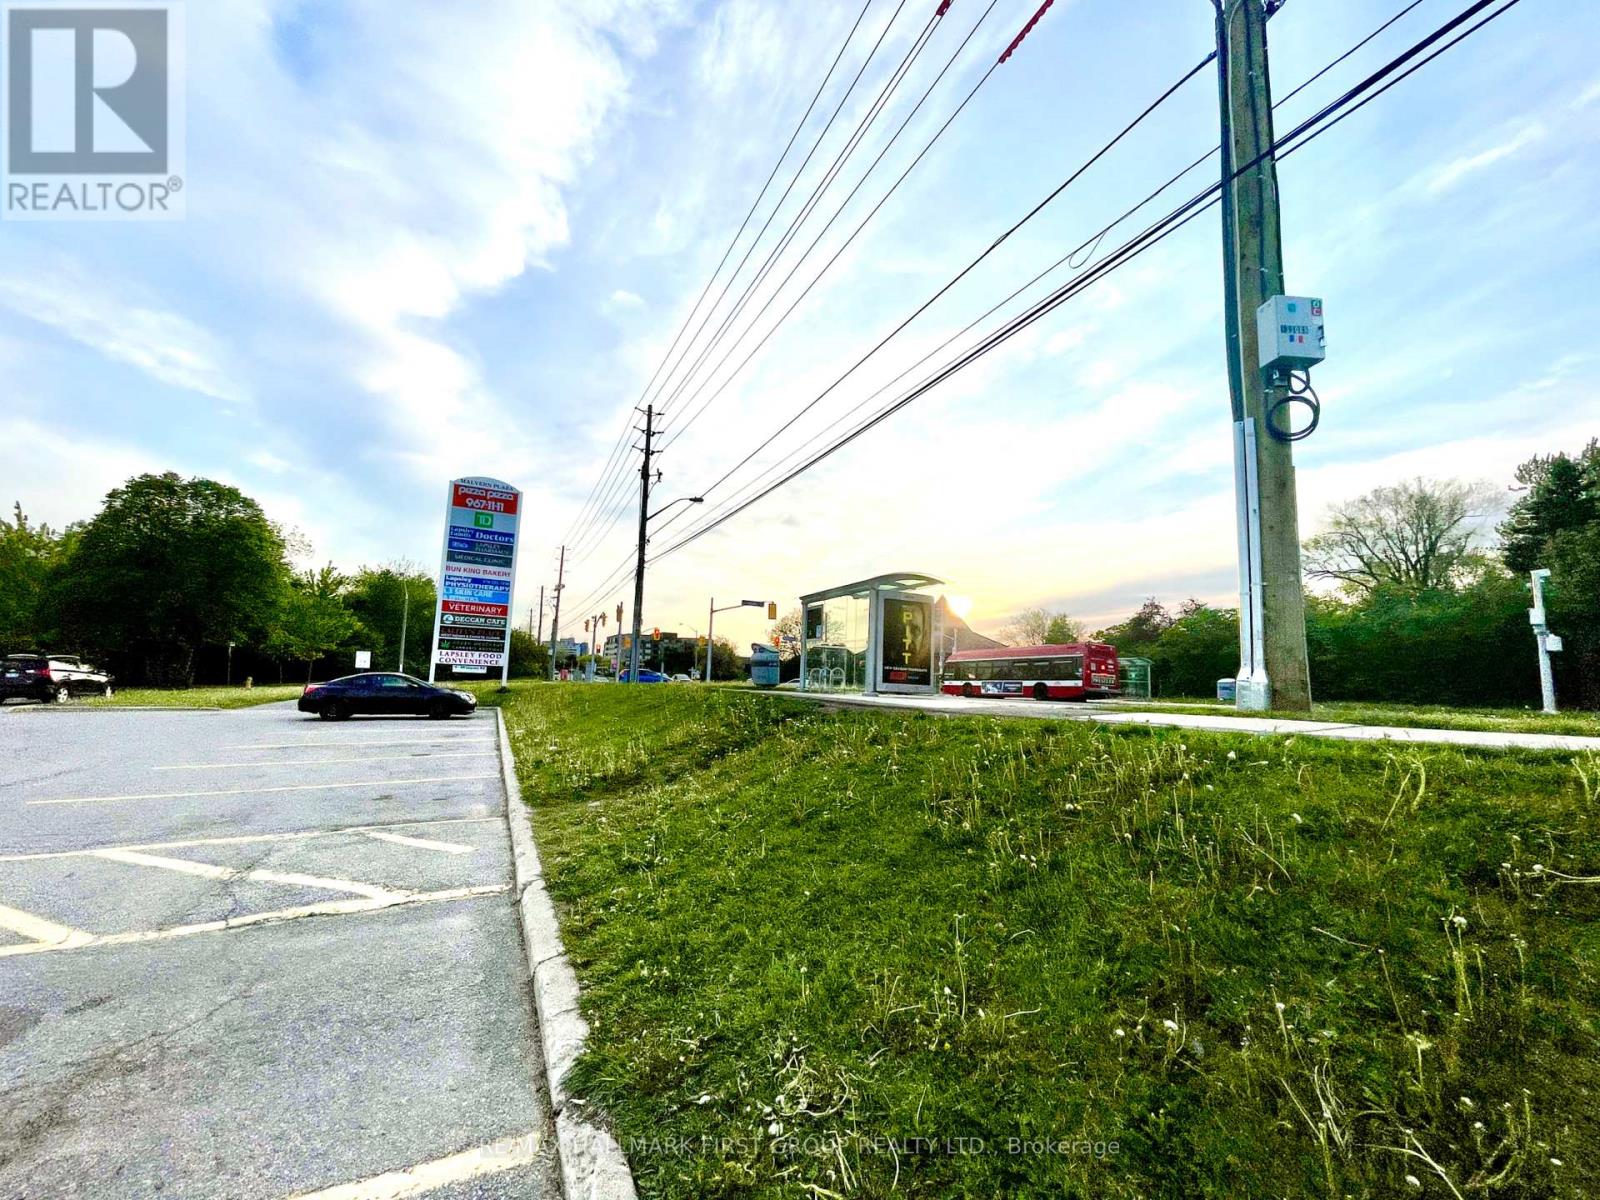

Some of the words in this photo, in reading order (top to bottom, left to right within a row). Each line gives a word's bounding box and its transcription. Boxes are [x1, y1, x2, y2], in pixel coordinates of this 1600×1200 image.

[478, 515, 492, 526] TD
[475, 531, 514, 542] Doctors
[445, 564, 462, 573] BUN
[463, 567, 481, 575] KING
[482, 569, 511, 577] BAKERY
[445, 581, 510, 592] PHYSIOTHERAPY
[449, 603, 503, 614] VETERINARY
[454, 616, 485, 624] DECCAN
[439, 650, 476, 658] LAPSLEY
[439, 657, 500, 665] CONVENIENCE
